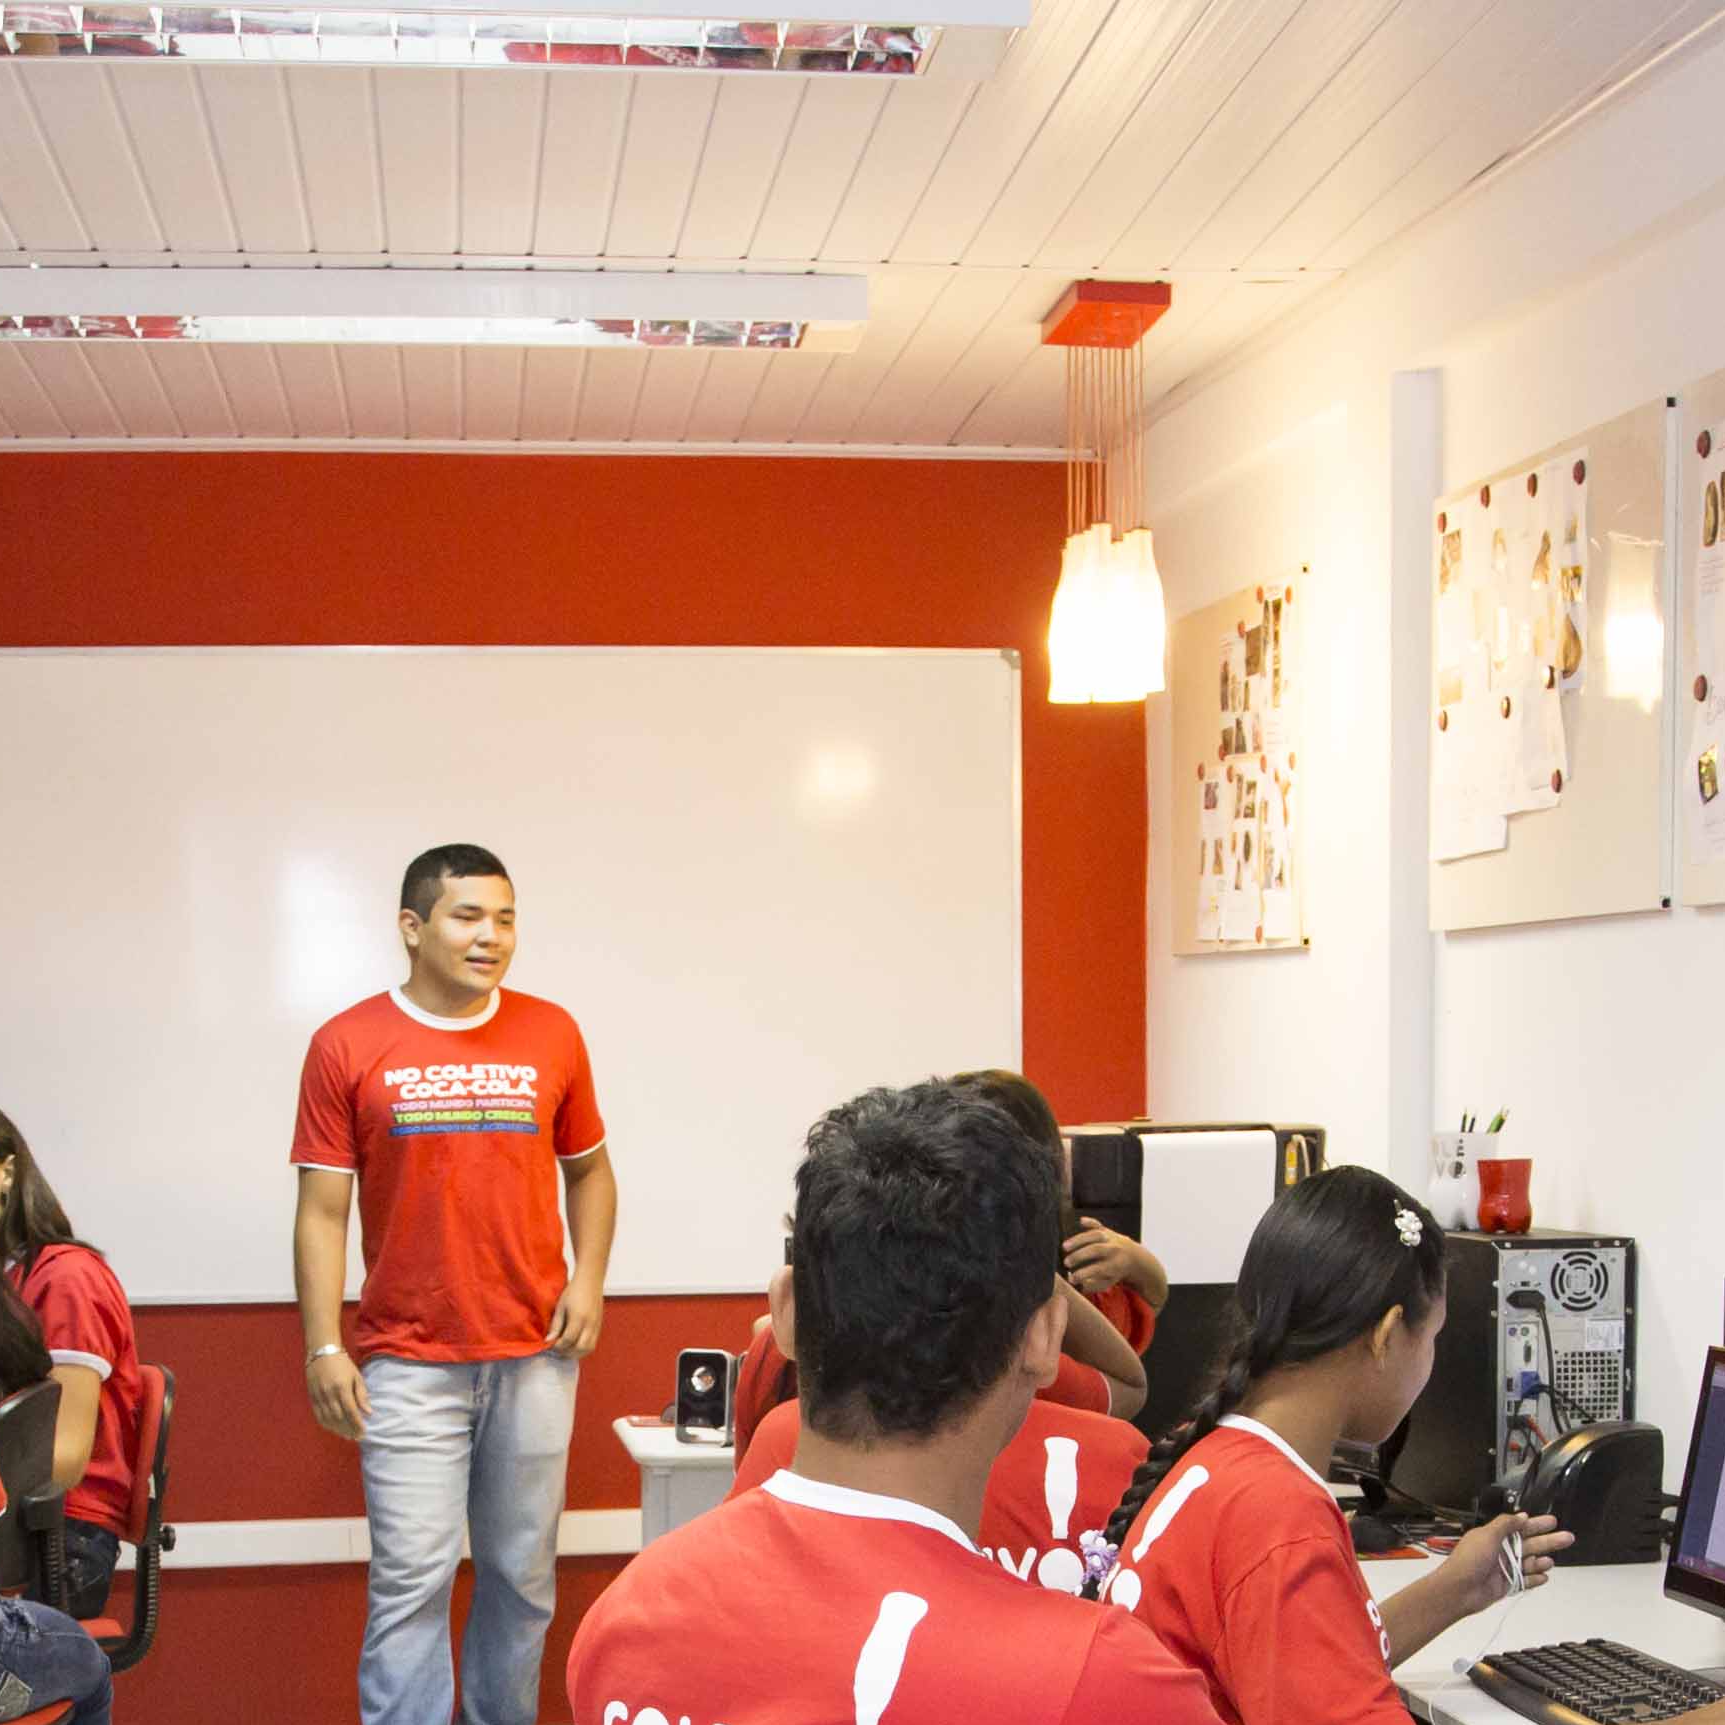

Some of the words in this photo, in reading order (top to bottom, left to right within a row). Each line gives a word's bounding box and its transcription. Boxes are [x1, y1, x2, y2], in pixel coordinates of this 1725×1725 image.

[383, 1067, 422, 1087] NO
[424, 1063, 538, 1082] COLETIVO
[399, 1079, 538, 1099] COCA-COLA,
